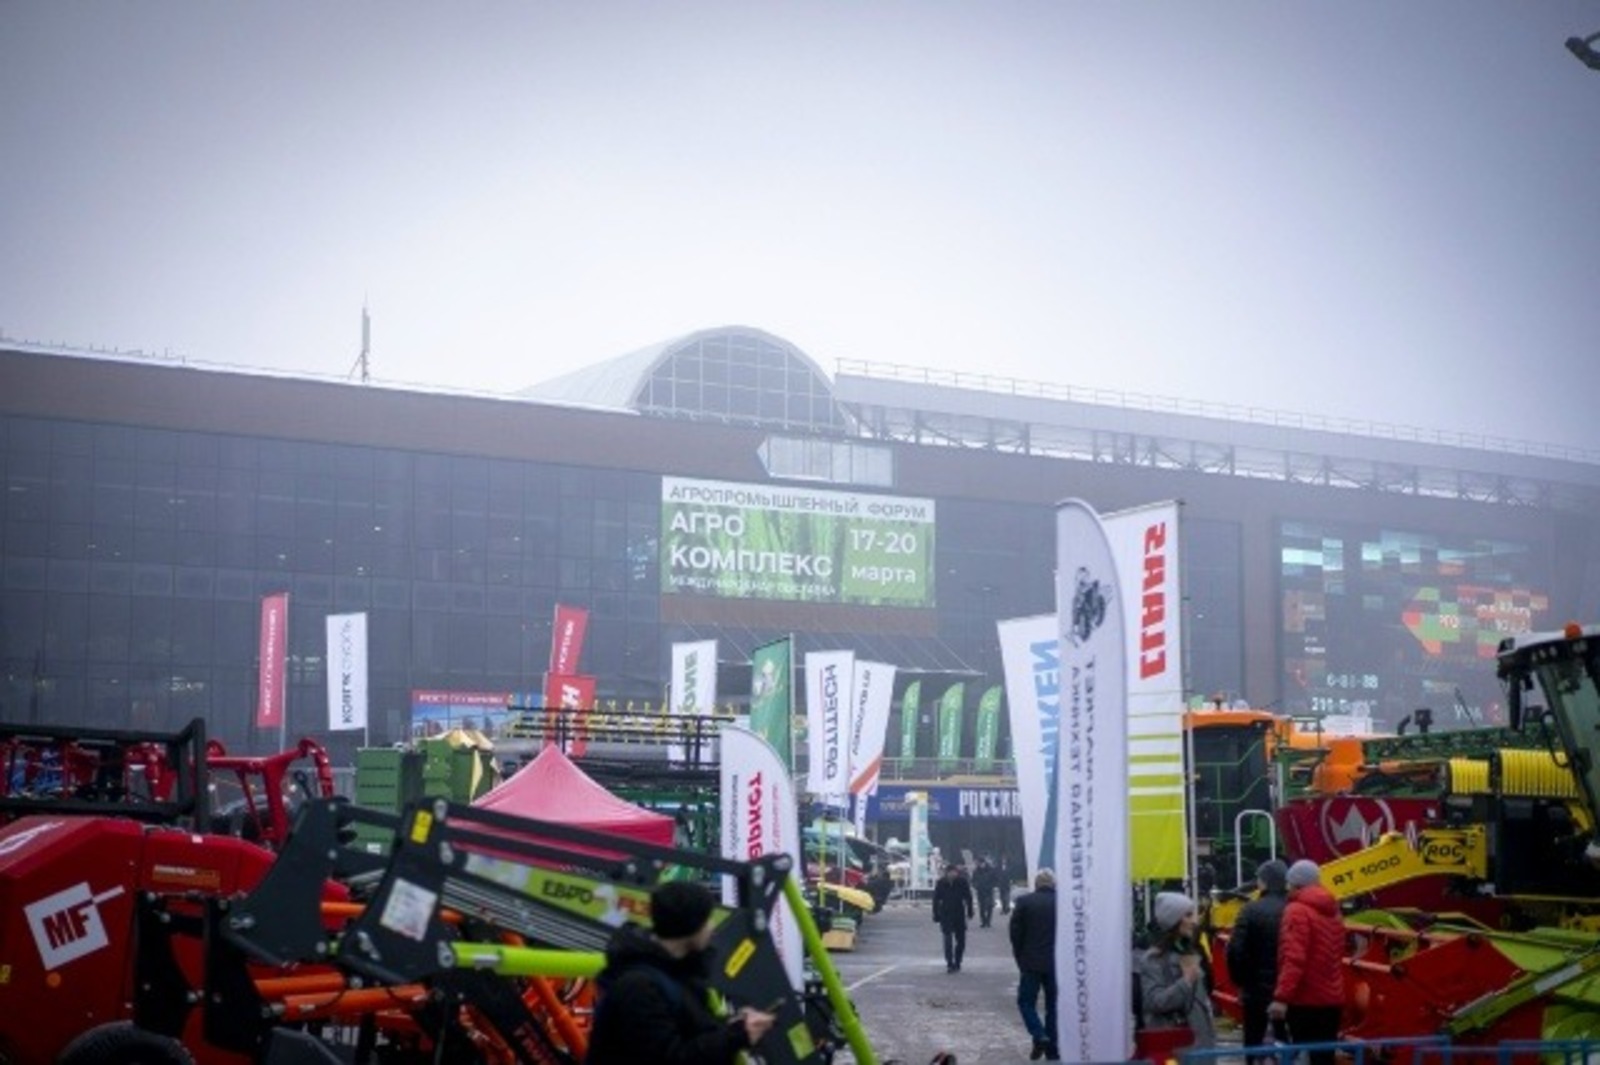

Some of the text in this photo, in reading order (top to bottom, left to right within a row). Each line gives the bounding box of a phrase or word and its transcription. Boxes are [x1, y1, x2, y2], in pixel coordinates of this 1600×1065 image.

[670, 485, 926, 518] АГРОПРОМЫШЛЕННЫЙ ФОРУМ
[670, 510, 744, 537] АГРО
[850, 530, 917, 554] 17-20
[670, 545, 833, 577] КОМПЛЕКС
[852, 565, 916, 585] марта
[1427, 842, 1464, 858] ROC
[1332, 854, 1401, 887] RT 1000
[42, 902, 93, 951] MF
